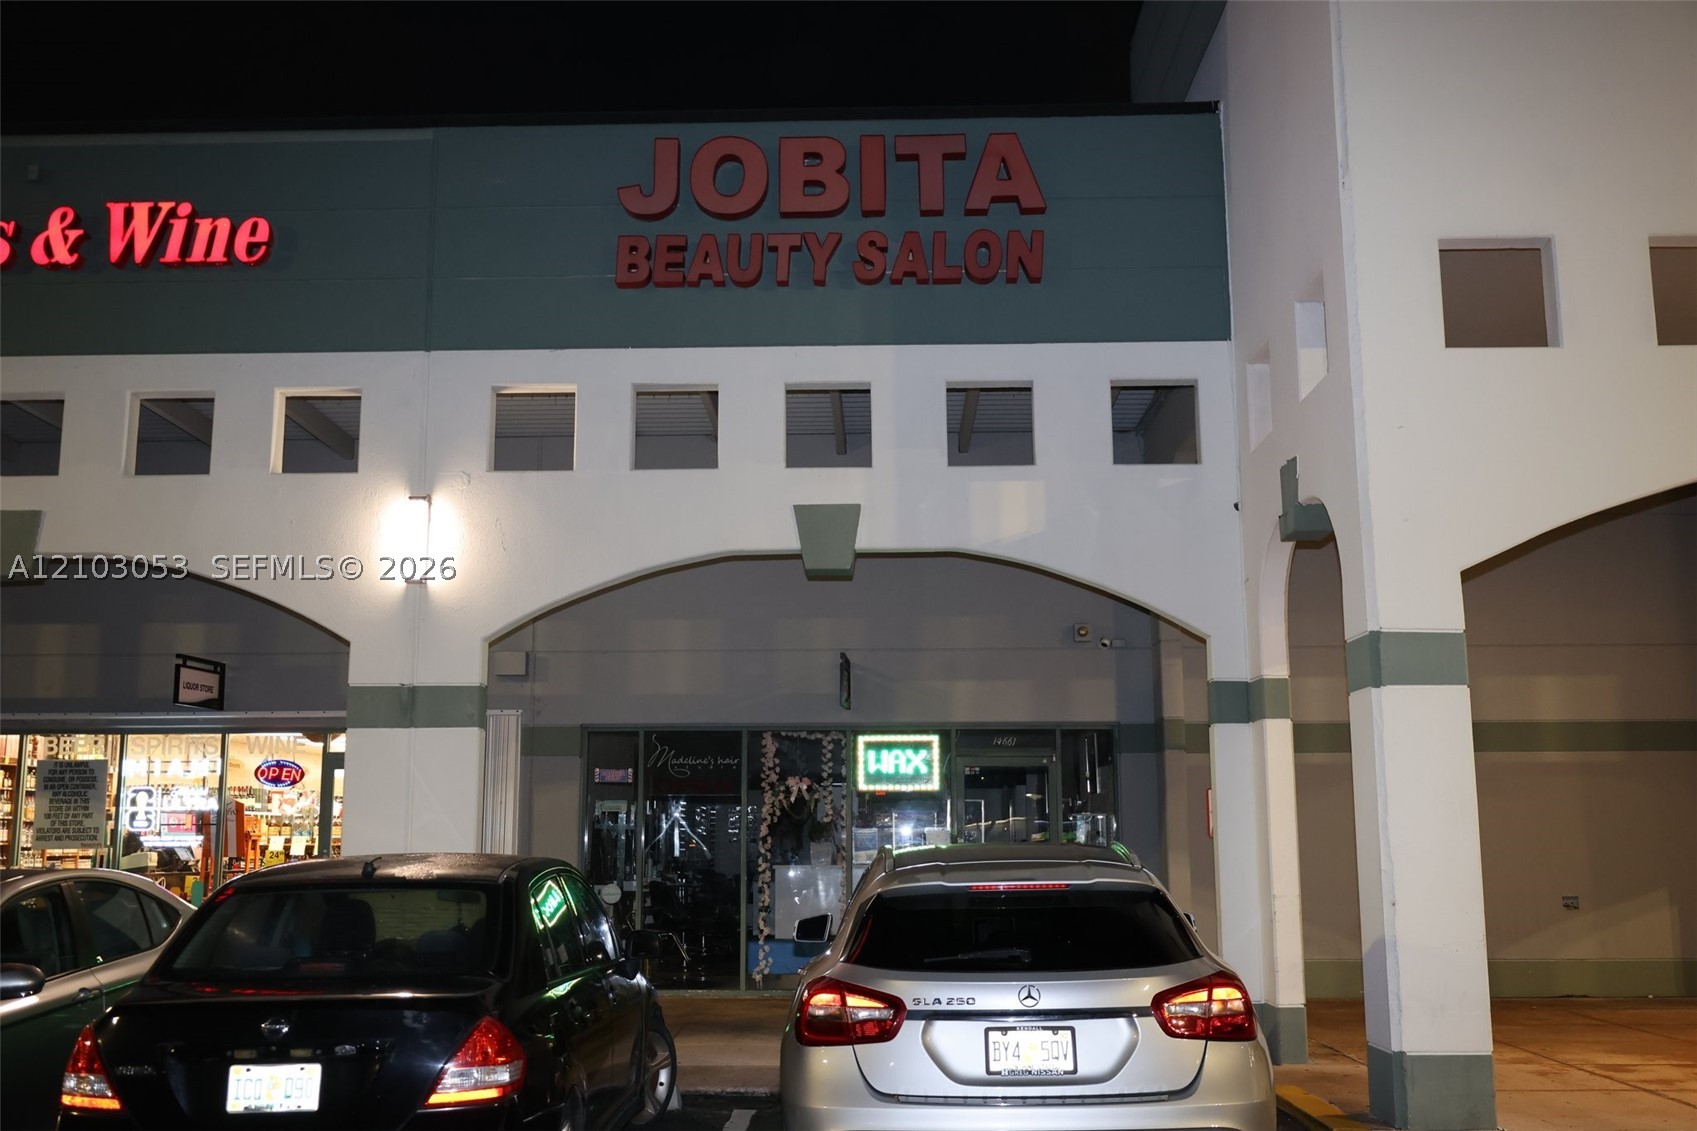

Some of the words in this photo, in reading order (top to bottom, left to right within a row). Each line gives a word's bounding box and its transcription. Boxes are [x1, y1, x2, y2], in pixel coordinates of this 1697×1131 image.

[617, 132, 1047, 221] JOBITA
[30, 206, 85, 266] &
[106, 201, 271, 265] Wine
[615, 232, 842, 288] BEAUTY
[852, 229, 1045, 286] SALON
[182, 681, 200, 691] LIQUOR
[200, 684, 214, 694] STORE
[130, 735, 220, 755] SPIRITS
[246, 735, 305, 755] WINE
[647, 733, 715, 778] Madeline's
[717, 756, 740, 765] hair
[867, 749, 929, 775] WAX
[257, 766, 302, 782] OPEN
[912, 997, 942, 1006] GLA
[946, 997, 976, 1006] 250
[992, 1041, 1021, 1062] BY4
